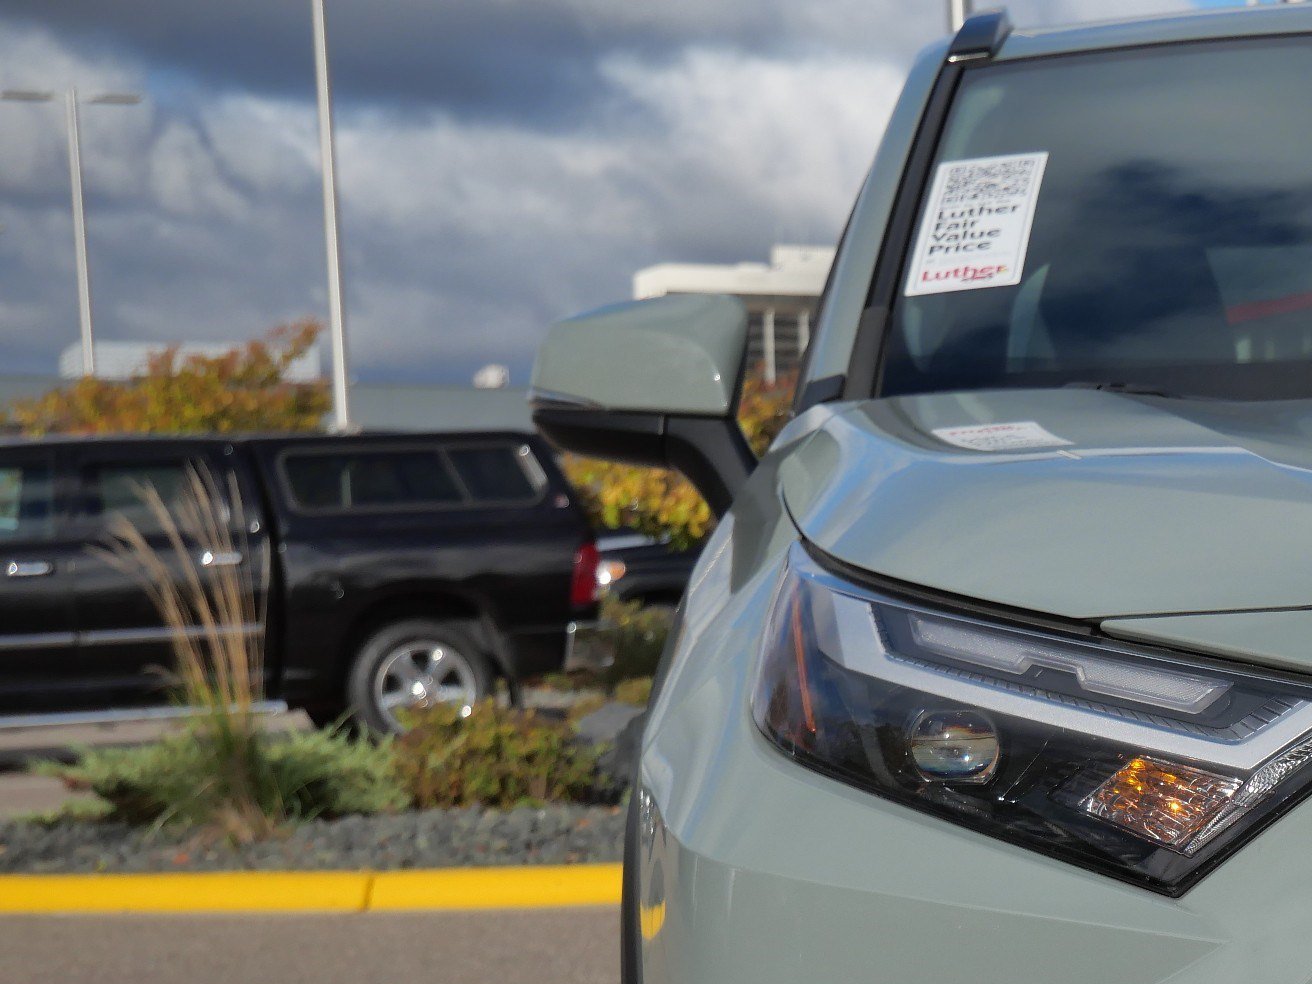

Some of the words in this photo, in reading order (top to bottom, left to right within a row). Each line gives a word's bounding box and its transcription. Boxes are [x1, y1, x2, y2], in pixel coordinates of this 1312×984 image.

[938, 204, 1019, 220] Luther
[935, 220, 980, 232] Fair
[931, 229, 1002, 242] Value
[928, 242, 992, 255] Price
[922, 265, 1007, 281] Luther
